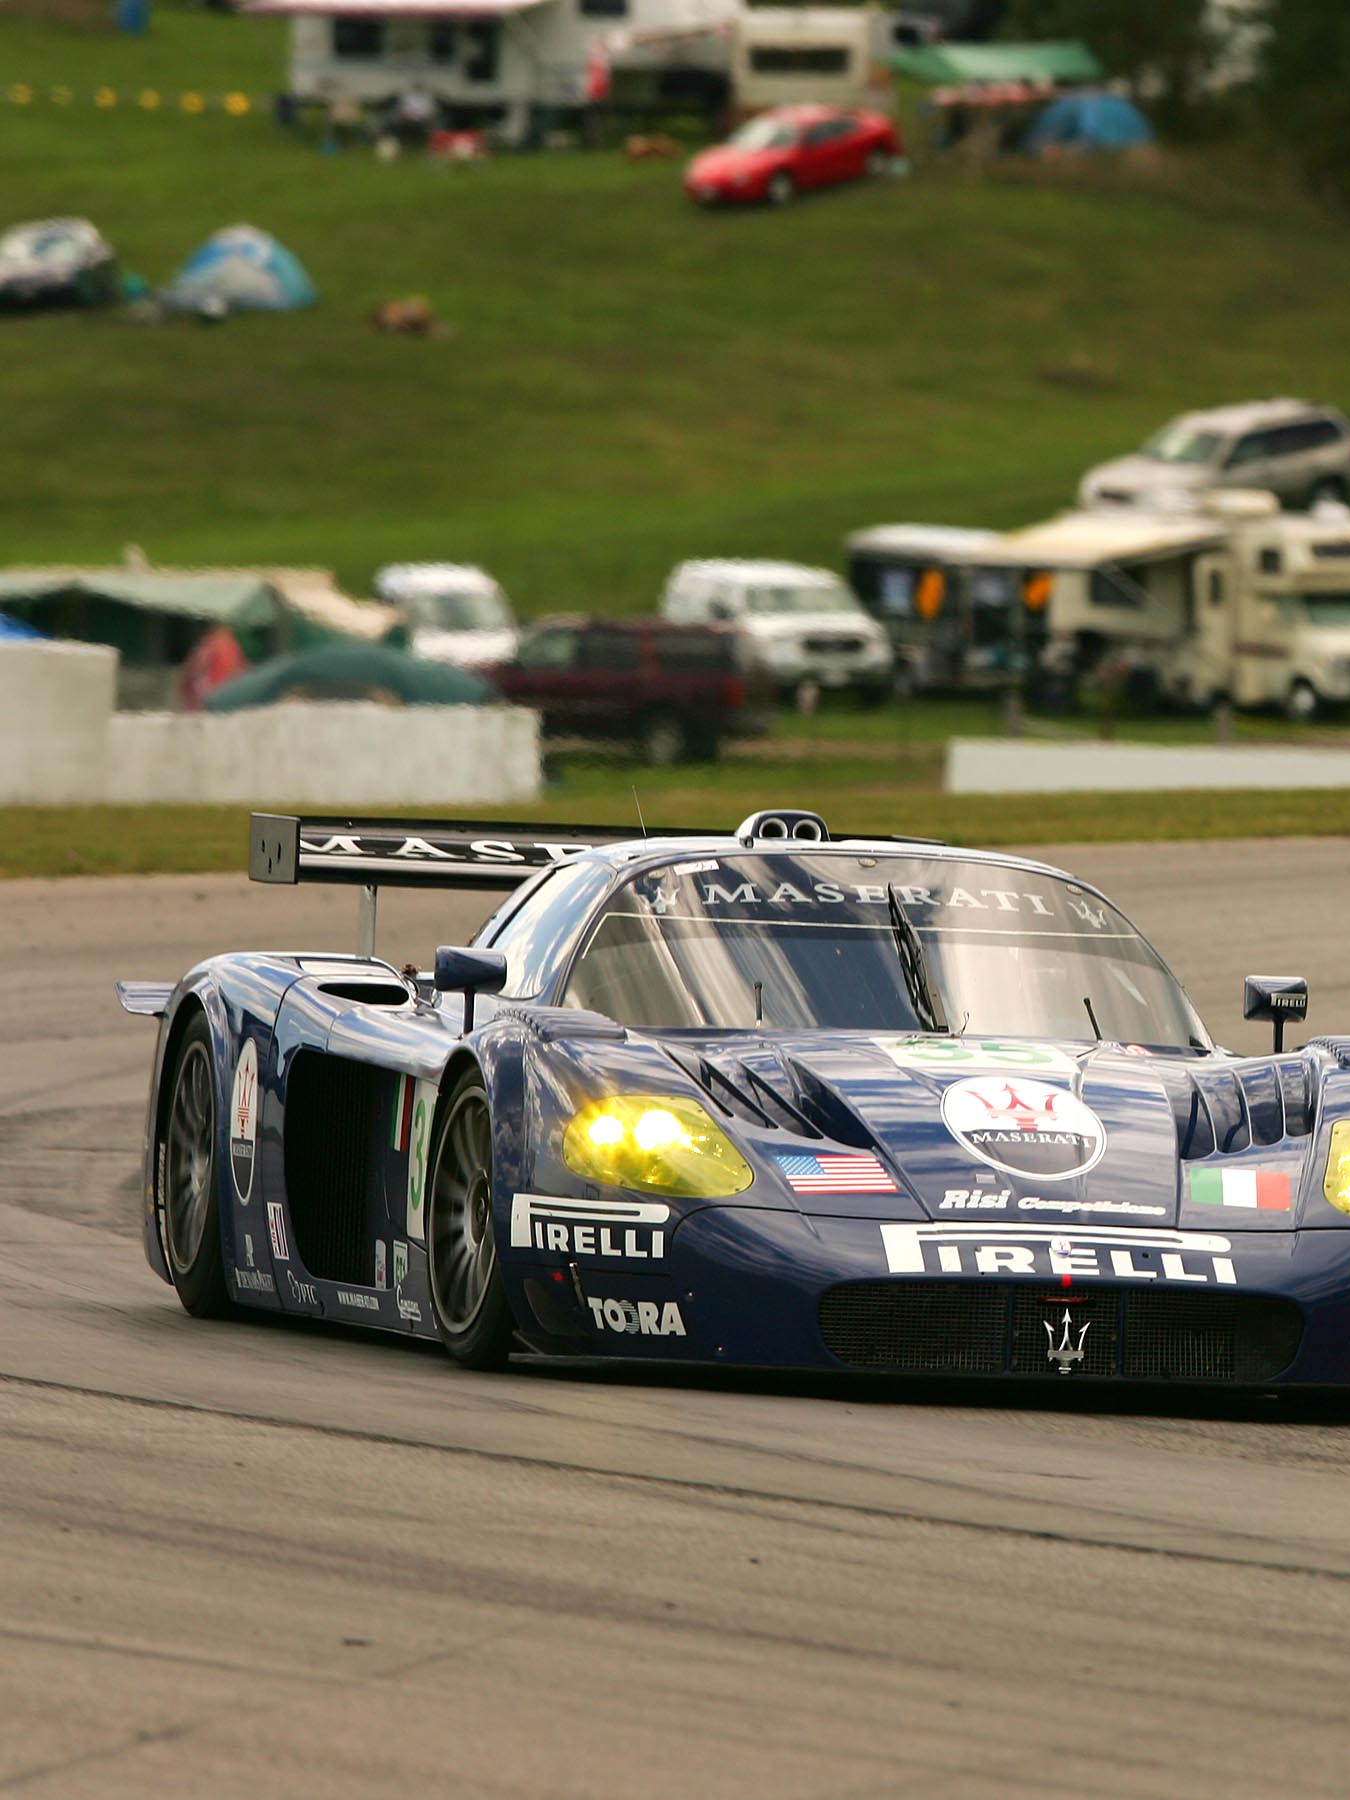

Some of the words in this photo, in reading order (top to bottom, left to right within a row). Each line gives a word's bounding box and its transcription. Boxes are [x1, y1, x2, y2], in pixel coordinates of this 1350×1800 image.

[701, 881, 1055, 916] MASERATI
[970, 1131, 1092, 1148] MASERATI
[939, 1189, 1012, 1209] Risi
[510, 1193, 671, 1259] PIRELLI
[879, 1221, 1238, 1285] PIRELLI
